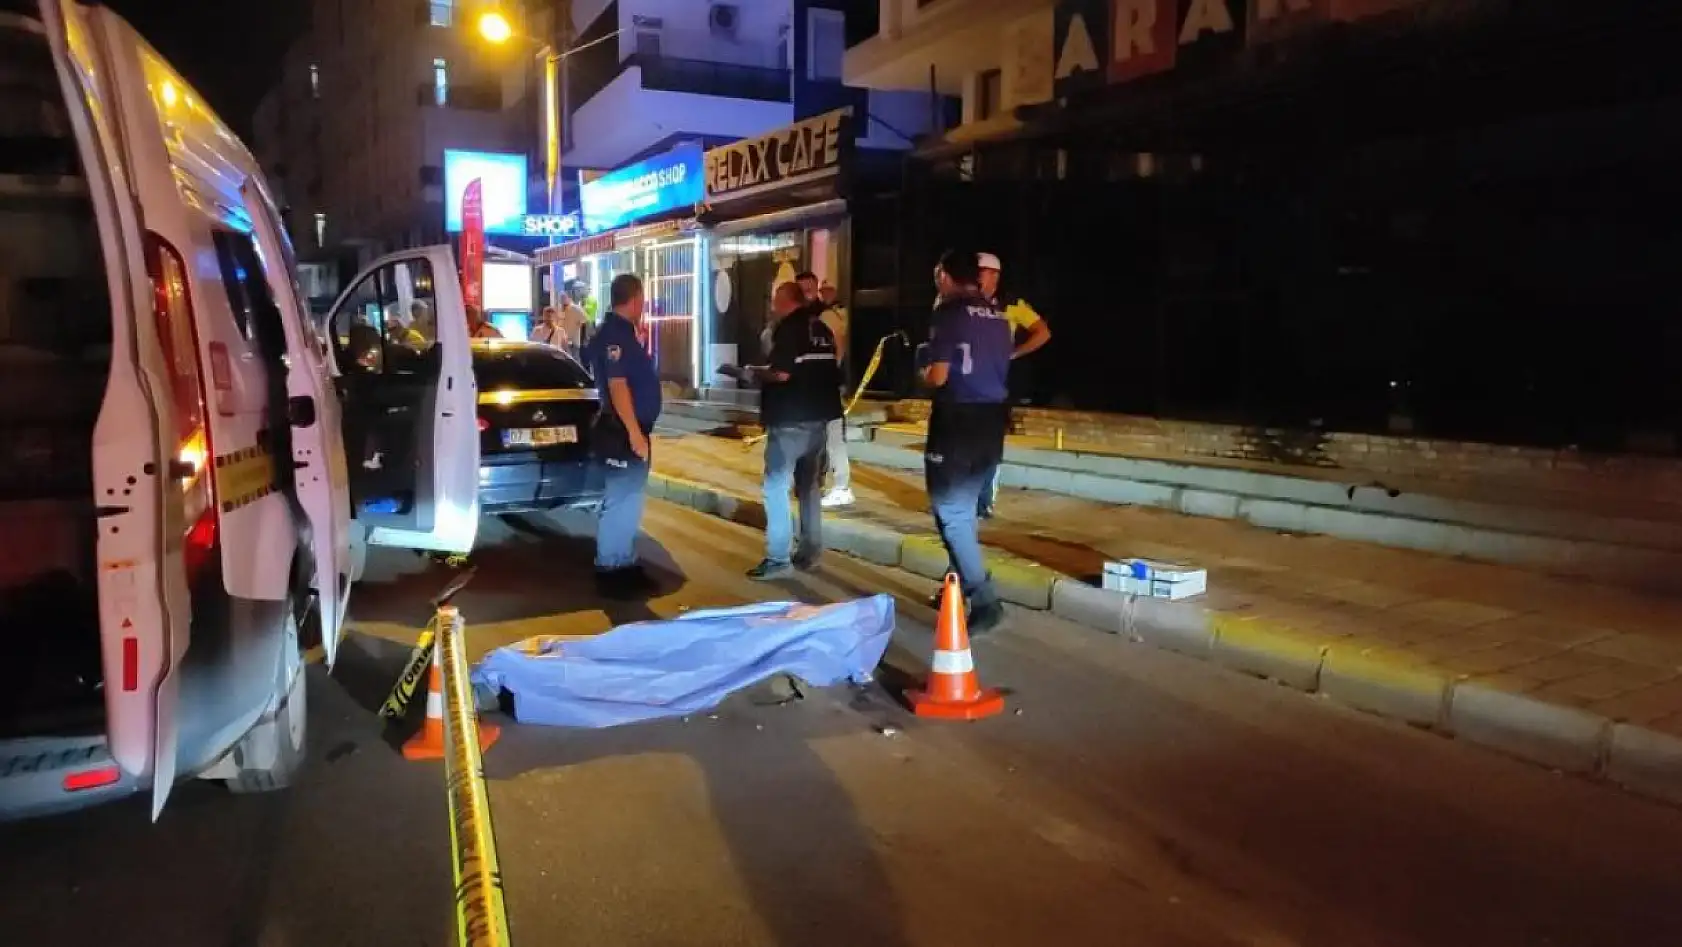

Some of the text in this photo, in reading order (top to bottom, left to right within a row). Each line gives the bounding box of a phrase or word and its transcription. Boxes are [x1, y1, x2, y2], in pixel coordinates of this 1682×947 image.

[706, 116, 840, 193] RELAX CAFE
[659, 162, 686, 189] SHOP
[524, 215, 574, 236] SHOP
